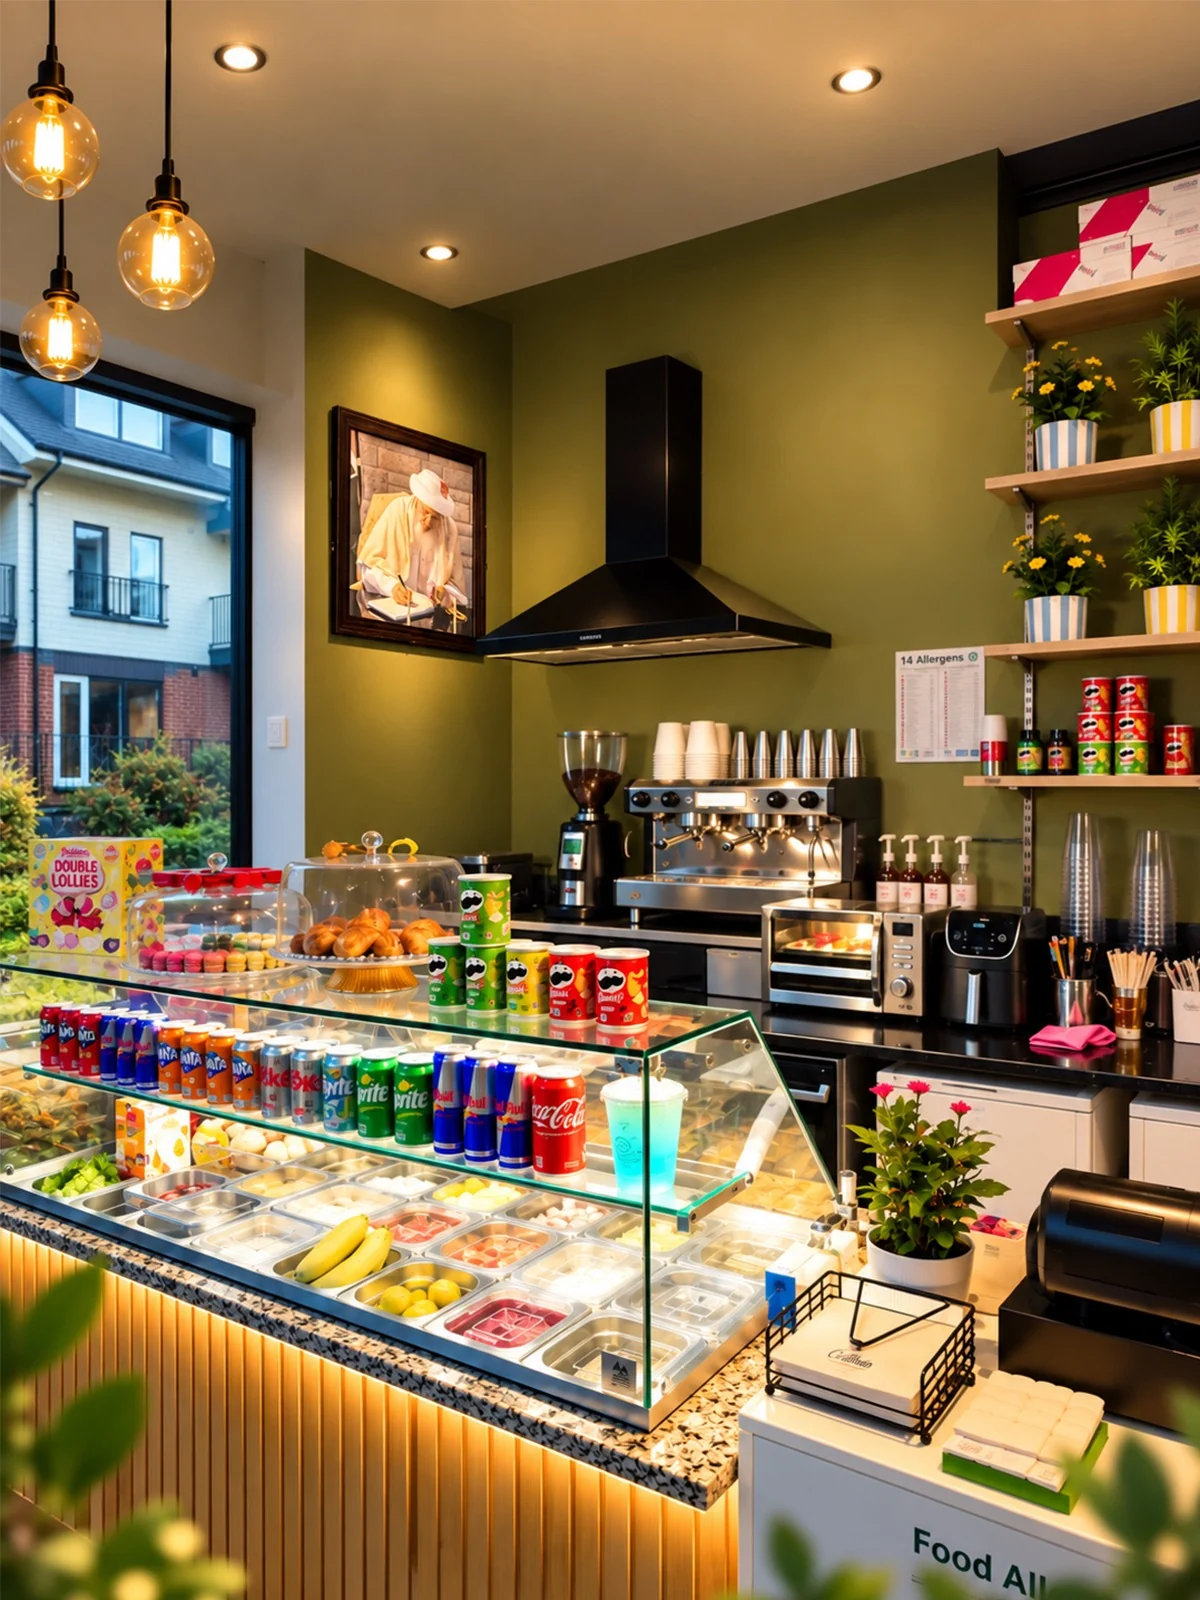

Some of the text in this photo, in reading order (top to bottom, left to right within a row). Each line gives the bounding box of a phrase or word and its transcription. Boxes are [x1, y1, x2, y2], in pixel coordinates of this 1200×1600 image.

[901, 654, 964, 665] 14 Allergens
[55, 860, 98, 873] DOUBLE
[51, 873, 98, 888] LOLLIES
[914, 1527, 1047, 1600] Food All
